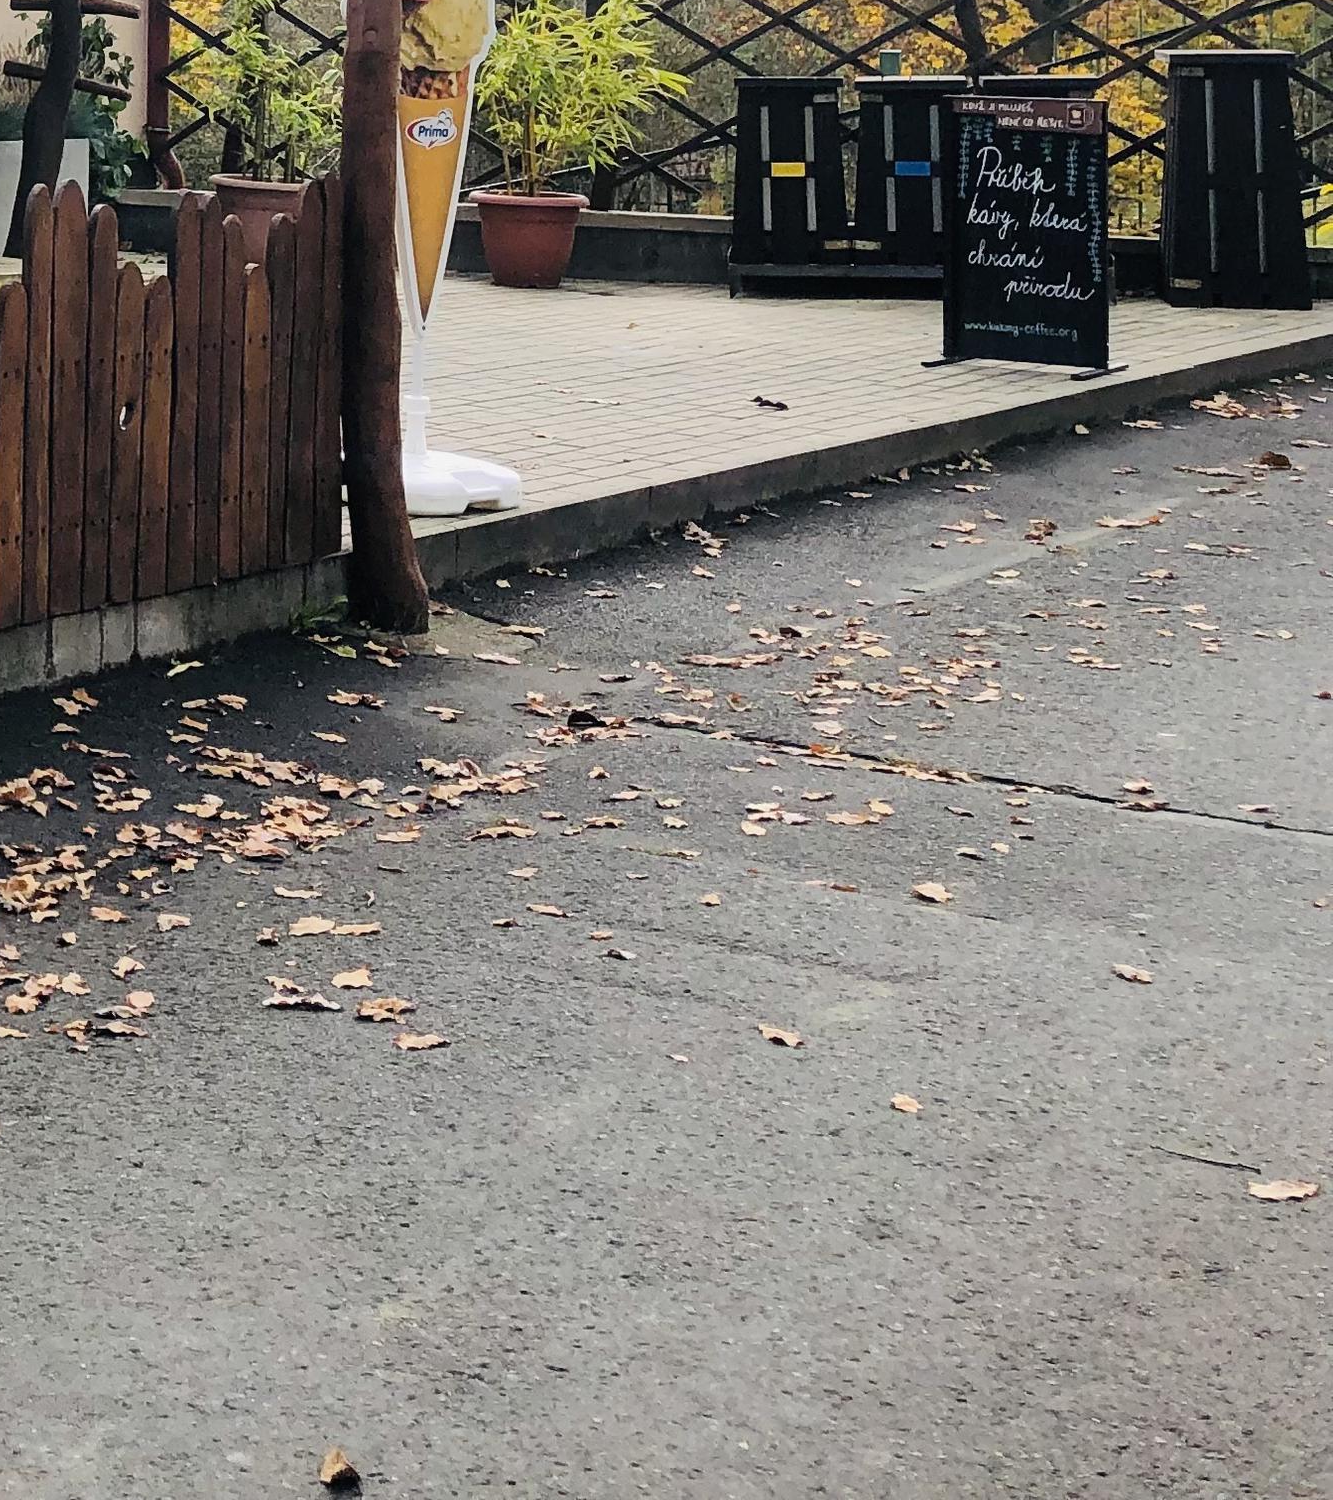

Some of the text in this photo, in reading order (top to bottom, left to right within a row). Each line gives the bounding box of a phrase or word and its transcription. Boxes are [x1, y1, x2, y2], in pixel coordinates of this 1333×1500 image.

[418, 124, 449, 138] Prima
[976, 146, 1056, 195] Příběh
[1029, 198, 1088, 232] která
[968, 238, 1045, 268] chrání
